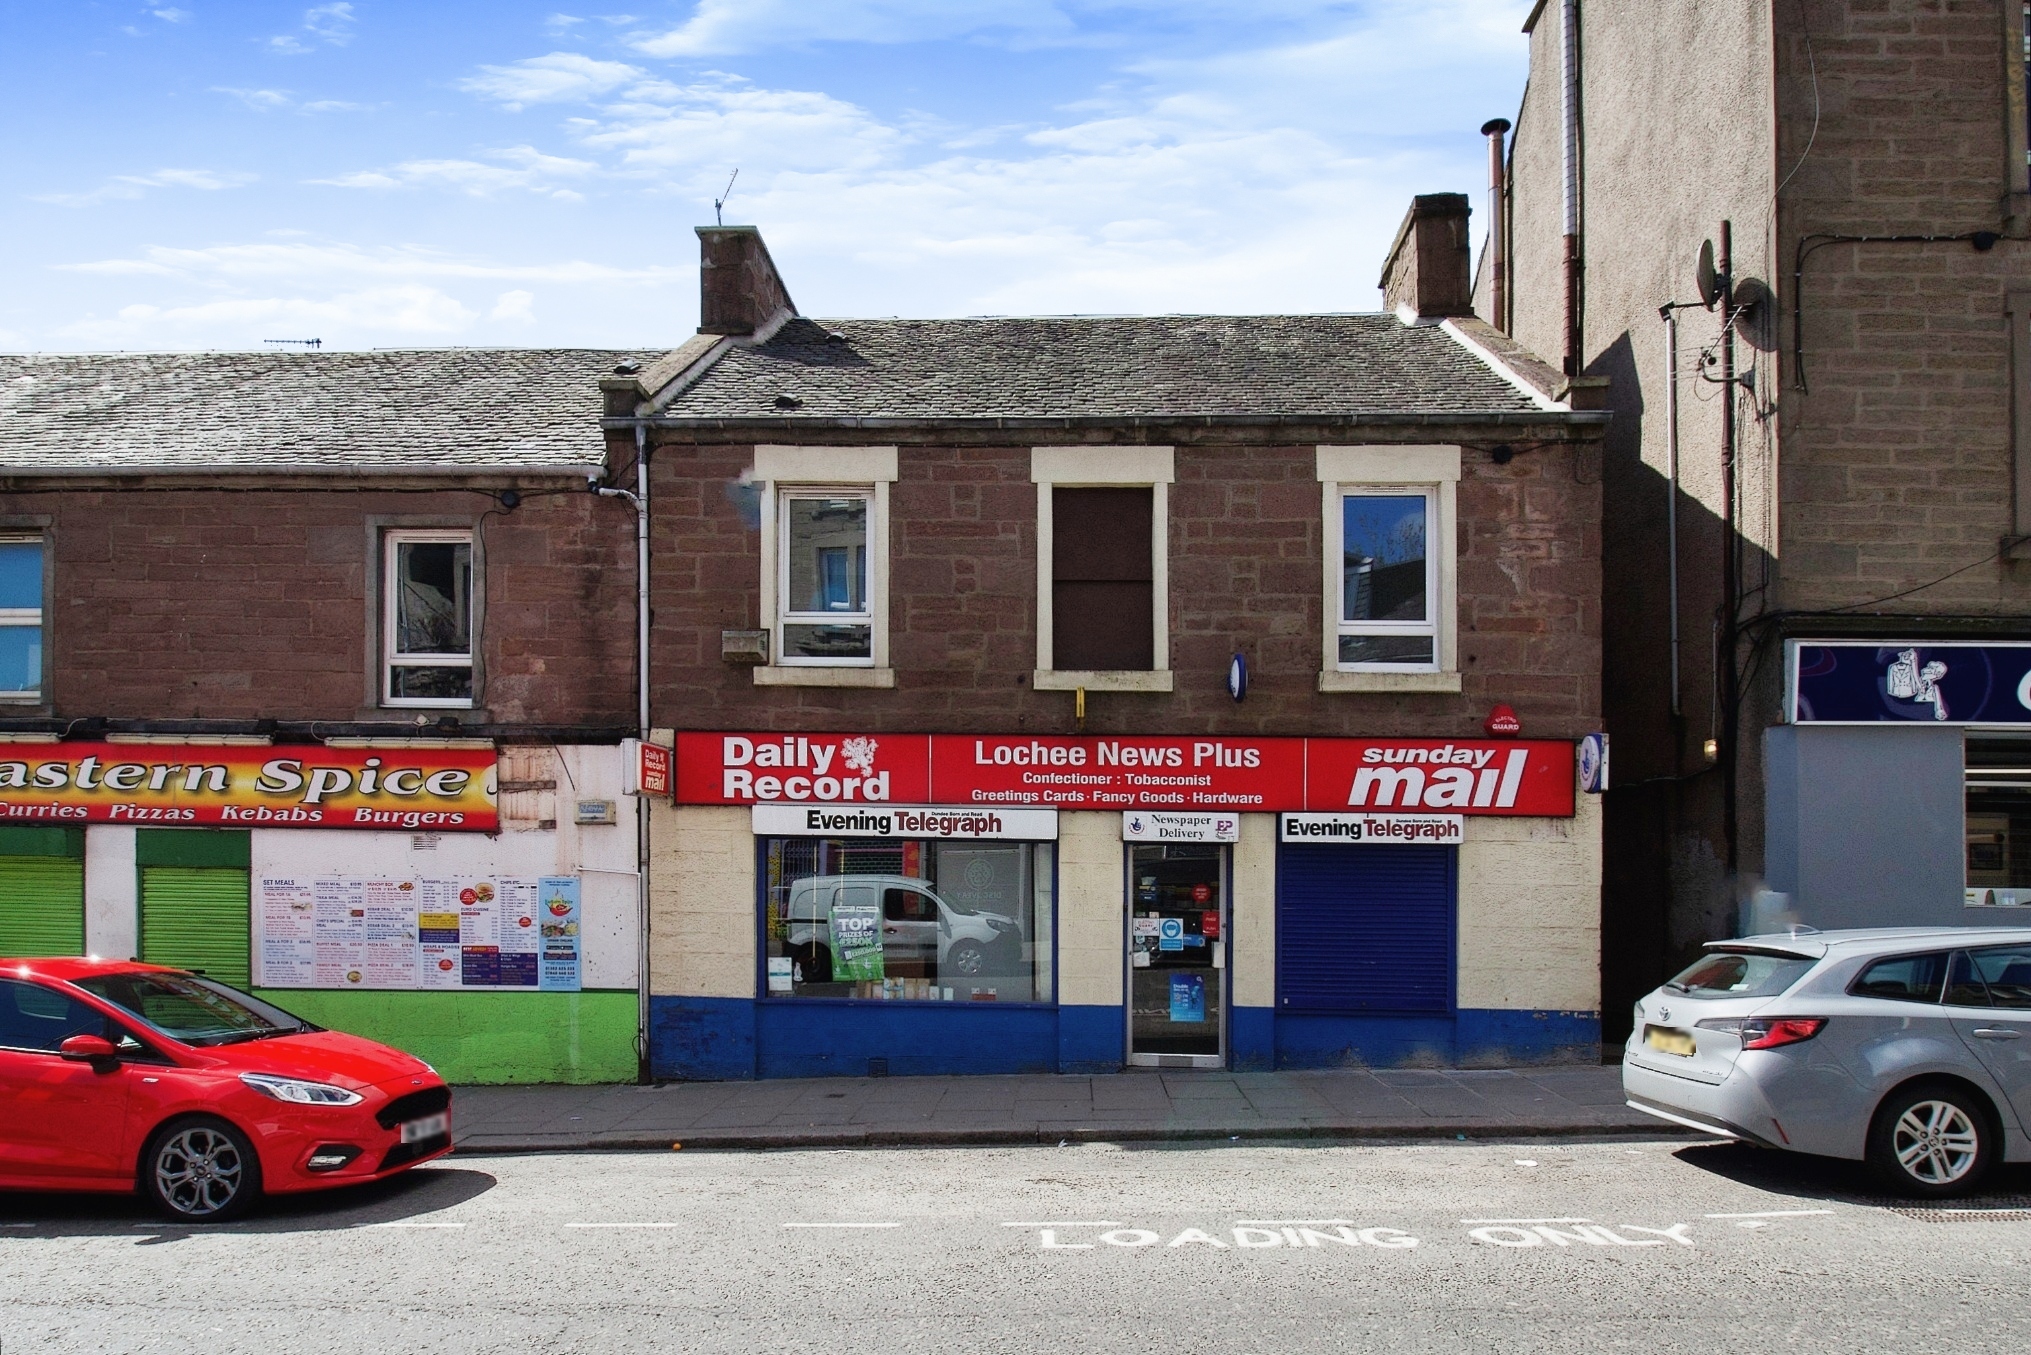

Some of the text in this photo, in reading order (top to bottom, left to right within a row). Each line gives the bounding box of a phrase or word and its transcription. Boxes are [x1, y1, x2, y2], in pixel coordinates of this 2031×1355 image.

[644, 749, 660, 763] Daily
[644, 759, 666, 771] Record
[723, 736, 836, 775] Daily
[975, 740, 1261, 768] Lochee News Plus
[1361, 744, 1497, 769] sunday
[254, 756, 471, 805] Spice
[644, 773, 666, 791] mail
[723, 768, 890, 801] Record
[1022, 771, 1113, 785] Confectioner
[1124, 773, 1212, 786] Tobacconist
[1347, 748, 1529, 808] mail
[971, 789, 1263, 805] Greetings Cards Fancy Goods Hardware
[109, 803, 196, 820] Pizzas
[220, 805, 323, 822] Kebabs
[353, 807, 464, 828] Burgers
[806, 809, 1002, 837] Evening Telegraph
[1151, 814, 1212, 827] Newspaper
[1159, 827, 1205, 841] Delivery
[1286, 818, 1459, 841] Evening Telegraph
[838, 917, 874, 932] TOP
[1041, 1223, 1695, 1249] LOADING ONLY
